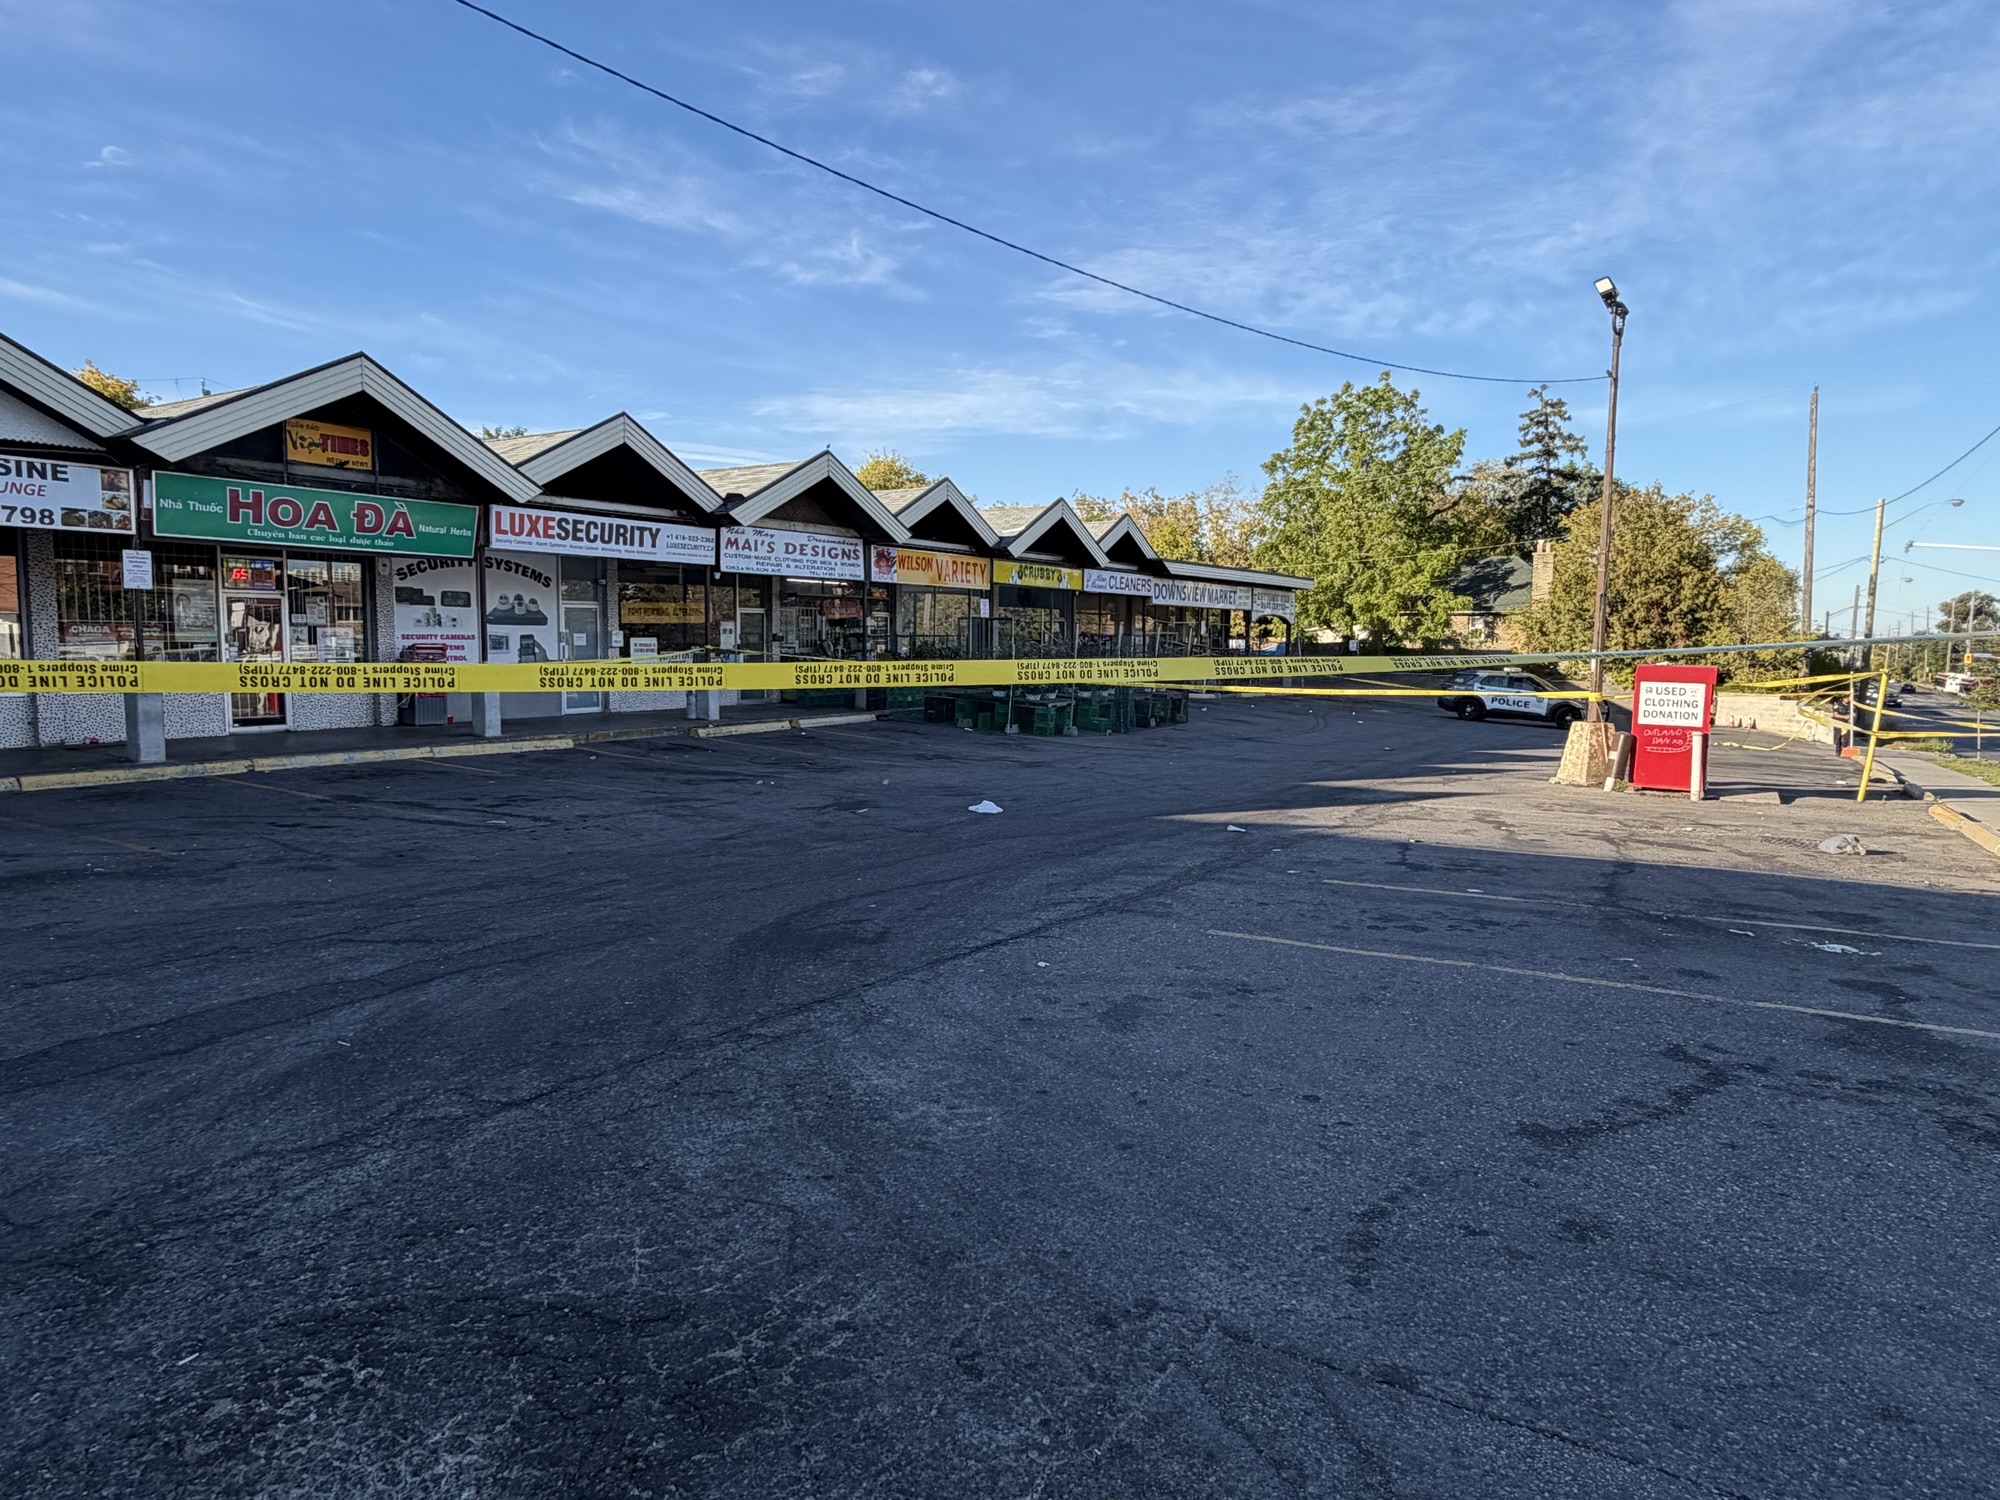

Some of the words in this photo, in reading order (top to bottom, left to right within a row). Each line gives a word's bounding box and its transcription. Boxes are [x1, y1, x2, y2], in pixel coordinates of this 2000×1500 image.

[320, 433, 370, 457] TIMES
[187, 500, 224, 514] Thuốc
[226, 486, 340, 532] HOA
[350, 500, 417, 539] ĐÀ
[418, 523, 447, 534] Natural
[450, 527, 472, 537] Herbs
[495, 511, 661, 548] LUXESECURITY
[806, 535, 859, 547] Dressmaking
[725, 537, 776, 553] MAI'S
[783, 542, 861, 561] DESIGNS
[724, 552, 772, 561] CUSTOM-MADE
[774, 556, 804, 564] CLOTHING
[484, 556, 552, 588] SYSTEMS
[794, 564, 836, 572] ALTERATION
[897, 554, 933, 572] WILSON
[935, 558, 987, 585] VARIETY
[1017, 565, 1063, 582] SCRUBBY'S
[1108, 575, 1152, 592] CLEANERS
[1153, 583, 1207, 601] DOWNSVIEW
[1207, 588, 1238, 605] MARKET
[71, 625, 111, 634] CHAGA
[401, 633, 438, 641] SECURITY
[440, 633, 476, 641] CAMERAS
[0, 664, 34, 674] 1-80
[38, 662, 97, 674] Stoppers
[101, 664, 138, 674] Crime
[239, 663, 274, 675] (TIPS)
[795, 664, 821, 674] (TIPS)
[892, 663, 929, 672] Stoppers
[1017, 661, 1040, 670] (TIPS)
[1103, 660, 1135, 668] Stoppers
[1136, 660, 1158, 668] Crime
[1271, 665, 1284, 674] DO
[1288, 665, 1308, 673] LINE
[1312, 664, 1344, 672] POLICE
[372, 665, 421, 676] Stoppers
[424, 666, 456, 676] Crime
[539, 665, 569, 676] (TIPS)
[652, 665, 693, 675] Stoppers
[696, 666, 723, 675] Crime
[1017, 670, 1051, 680] CROSS
[1056, 670, 1075, 679] NOT
[1080, 670, 1093, 679] DO
[1097, 669, 1119, 678] LINE
[1124, 668, 1159, 678] POLICE
[1215, 666, 1246, 676] CROSS
[1250, 666, 1268, 675] NOT
[0, 675, 19, 687] DO
[27, 675, 69, 688] LINE
[76, 675, 139, 688] POLICE
[239, 676, 291, 688] CROSS
[299, 676, 329, 688] NOT
[336, 676, 355, 688] DO
[363, 677, 396, 688] LINE
[403, 677, 456, 688] POLICE
[539, 677, 583, 688] CROSS
[590, 677, 615, 688] NOT
[621, 677, 638, 687] DO
[644, 677, 672, 687] LINE
[678, 676, 723, 686] POLICE
[795, 674, 833, 685] CROSS
[838, 673, 860, 684] NOT
[866, 673, 880, 684] DO
[885, 673, 910, 683] LINE
[915, 672, 954, 682] POLICE
[1656, 687, 1687, 696] USED
[1490, 696, 1531, 709] POLICE
[1644, 698, 1699, 708] CLOTHING
[1643, 709, 1699, 720] DONATION
